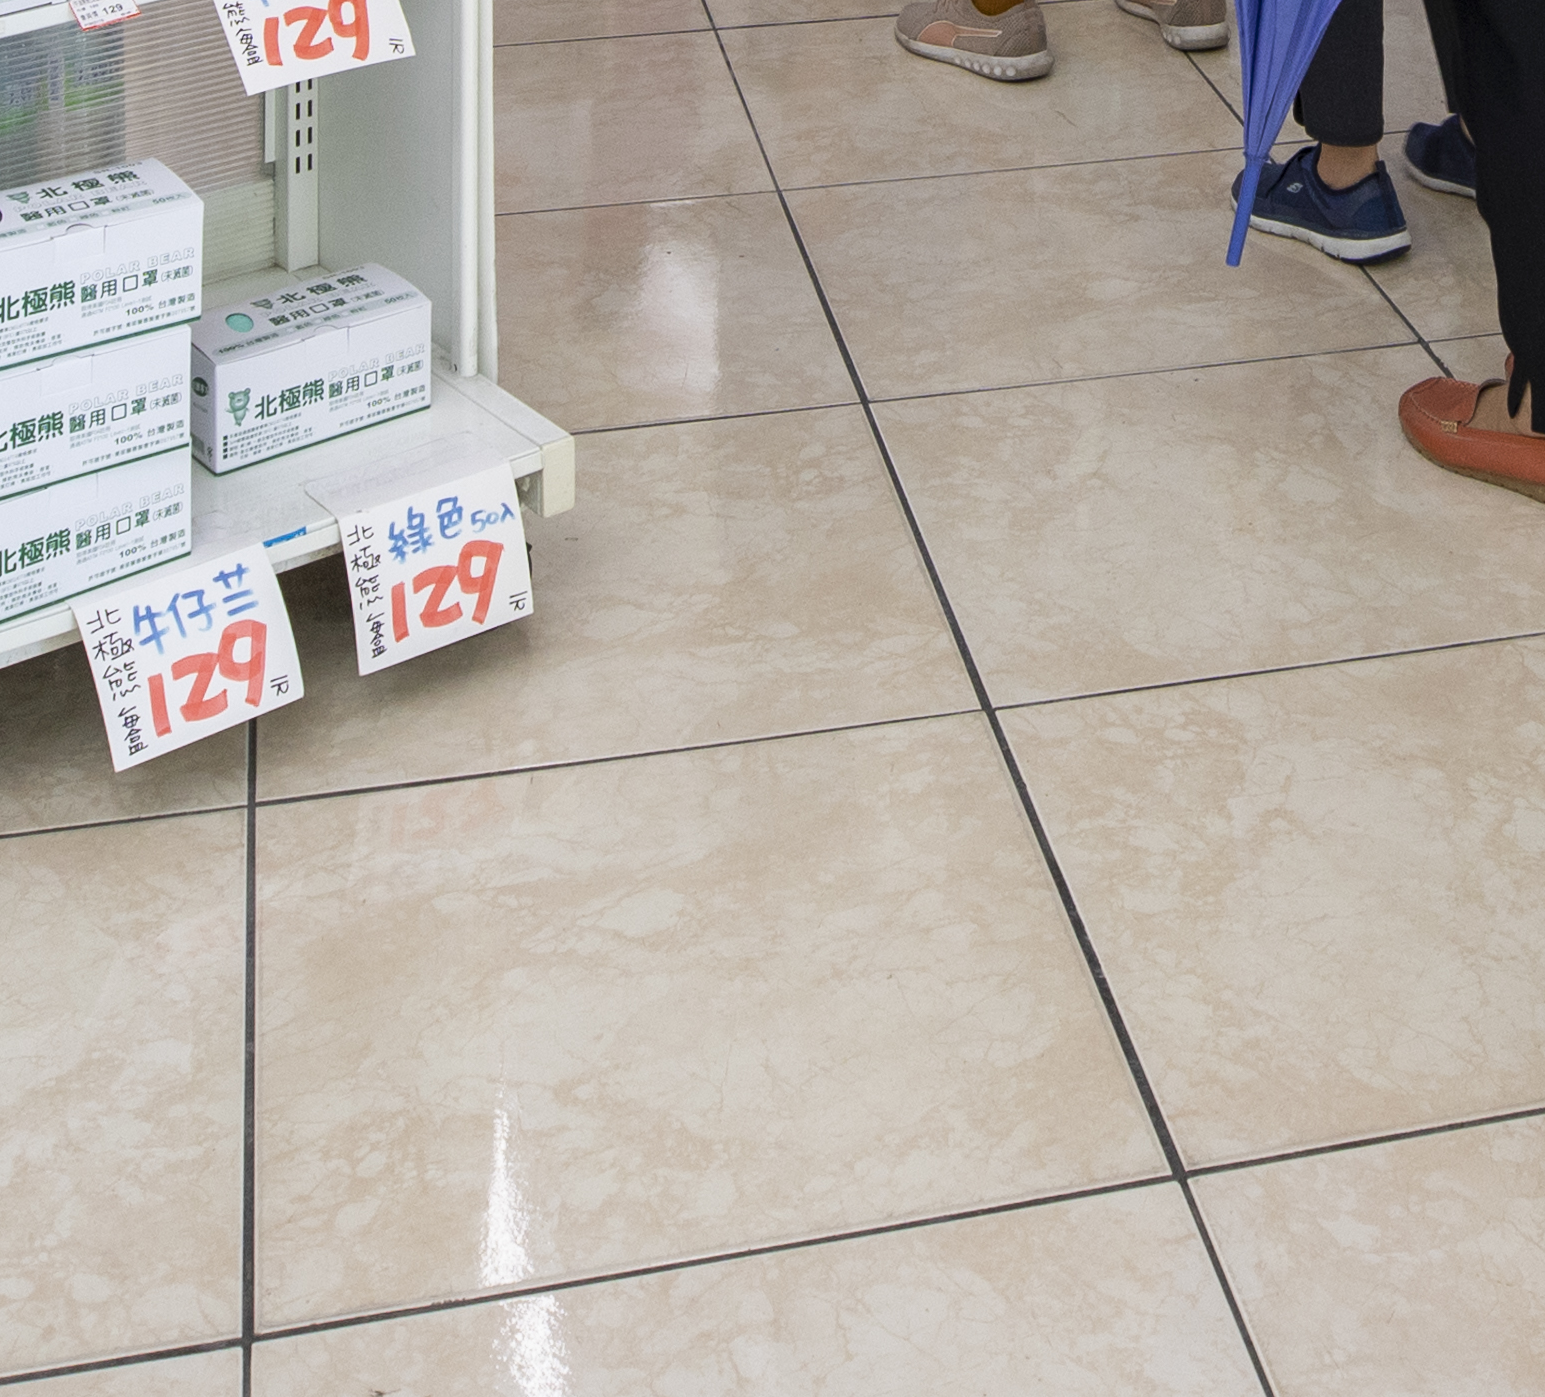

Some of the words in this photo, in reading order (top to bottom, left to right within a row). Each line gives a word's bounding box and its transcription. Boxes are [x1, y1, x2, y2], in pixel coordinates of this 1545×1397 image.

[101, 2, 123, 15] 129
[391, 540, 504, 643] 129
[148, 619, 268, 737] 129
